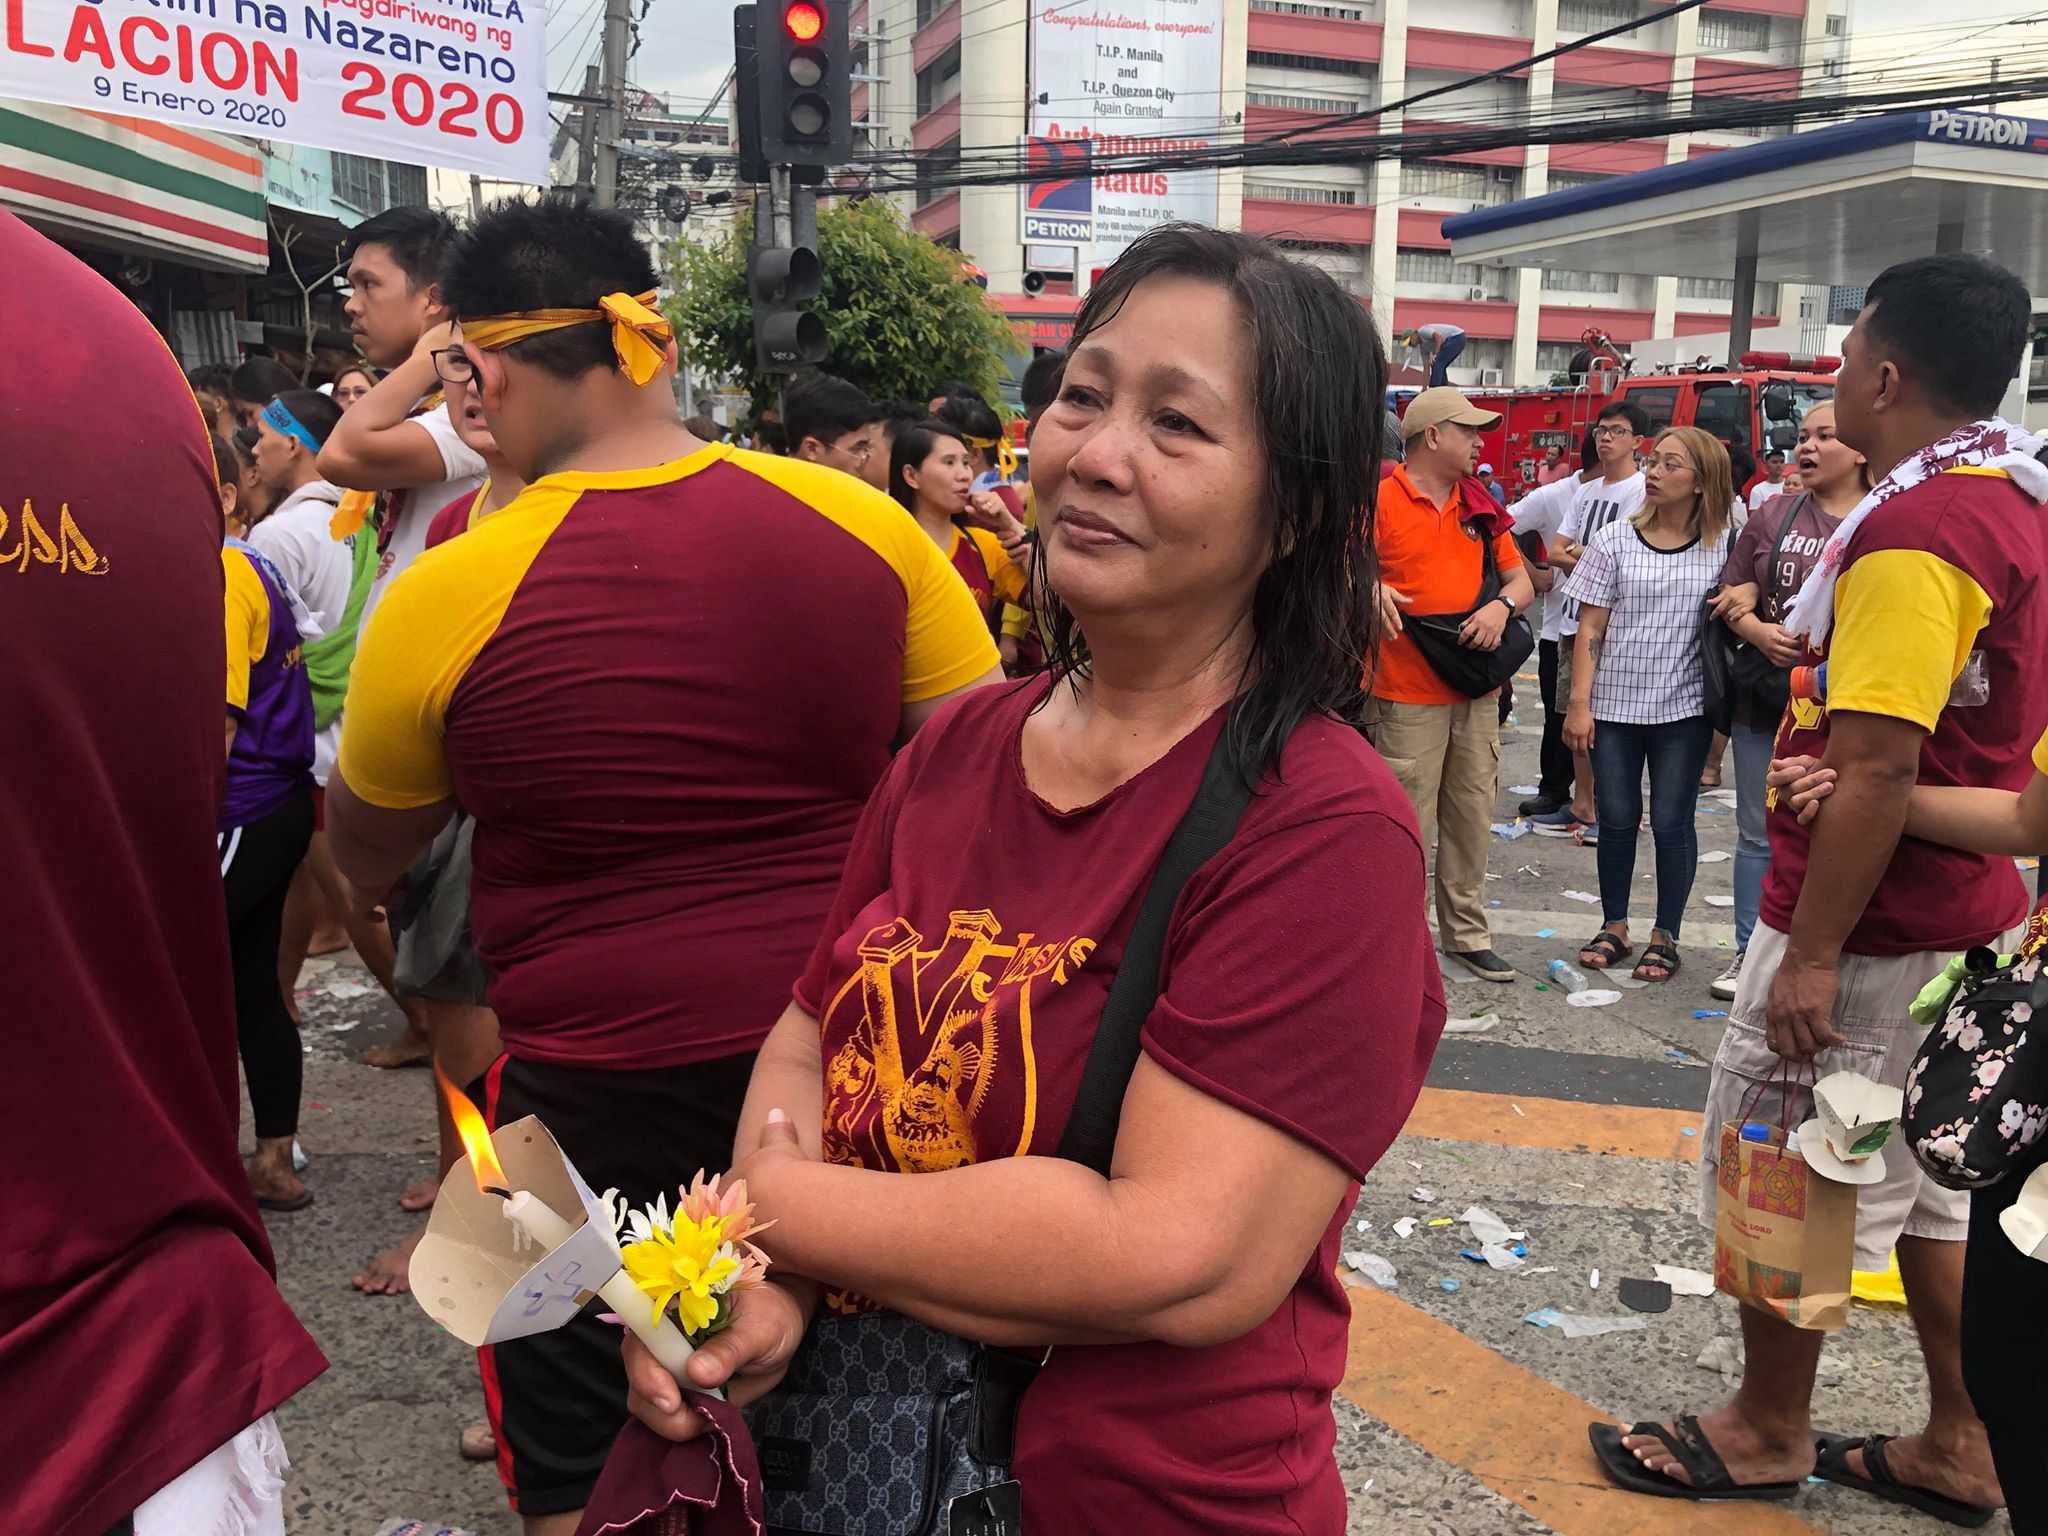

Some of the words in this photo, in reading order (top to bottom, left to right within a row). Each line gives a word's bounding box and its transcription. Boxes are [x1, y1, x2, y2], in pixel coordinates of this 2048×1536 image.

[1043, 8, 1151, 31] Congratulations,
[1155, 22, 1216, 38] everyone!
[234, 0, 287, 33] na
[305, 5, 515, 83] Nazareno
[487, 27, 512, 51] ng
[1096, 45, 1124, 58] T.I.P.
[1127, 48, 1164, 63] Manila
[7, 0, 299, 103] LACION
[341, 61, 524, 144] 2020
[1118, 67, 1138, 79] and
[93, 76, 111, 97] 9
[122, 82, 215, 116] Enero
[224, 98, 286, 128] 2020
[1083, 80, 1109, 95] T.I.P.
[1112, 83, 1153, 98] Quezon
[1156, 88, 1175, 103] City
[1093, 101, 1121, 116] Again
[1124, 103, 1164, 118] Granted
[1928, 109, 2028, 145] PETRON
[1098, 205, 1126, 217] Manila
[1127, 209, 1140, 217] and
[1026, 219, 1091, 238] PETRON
